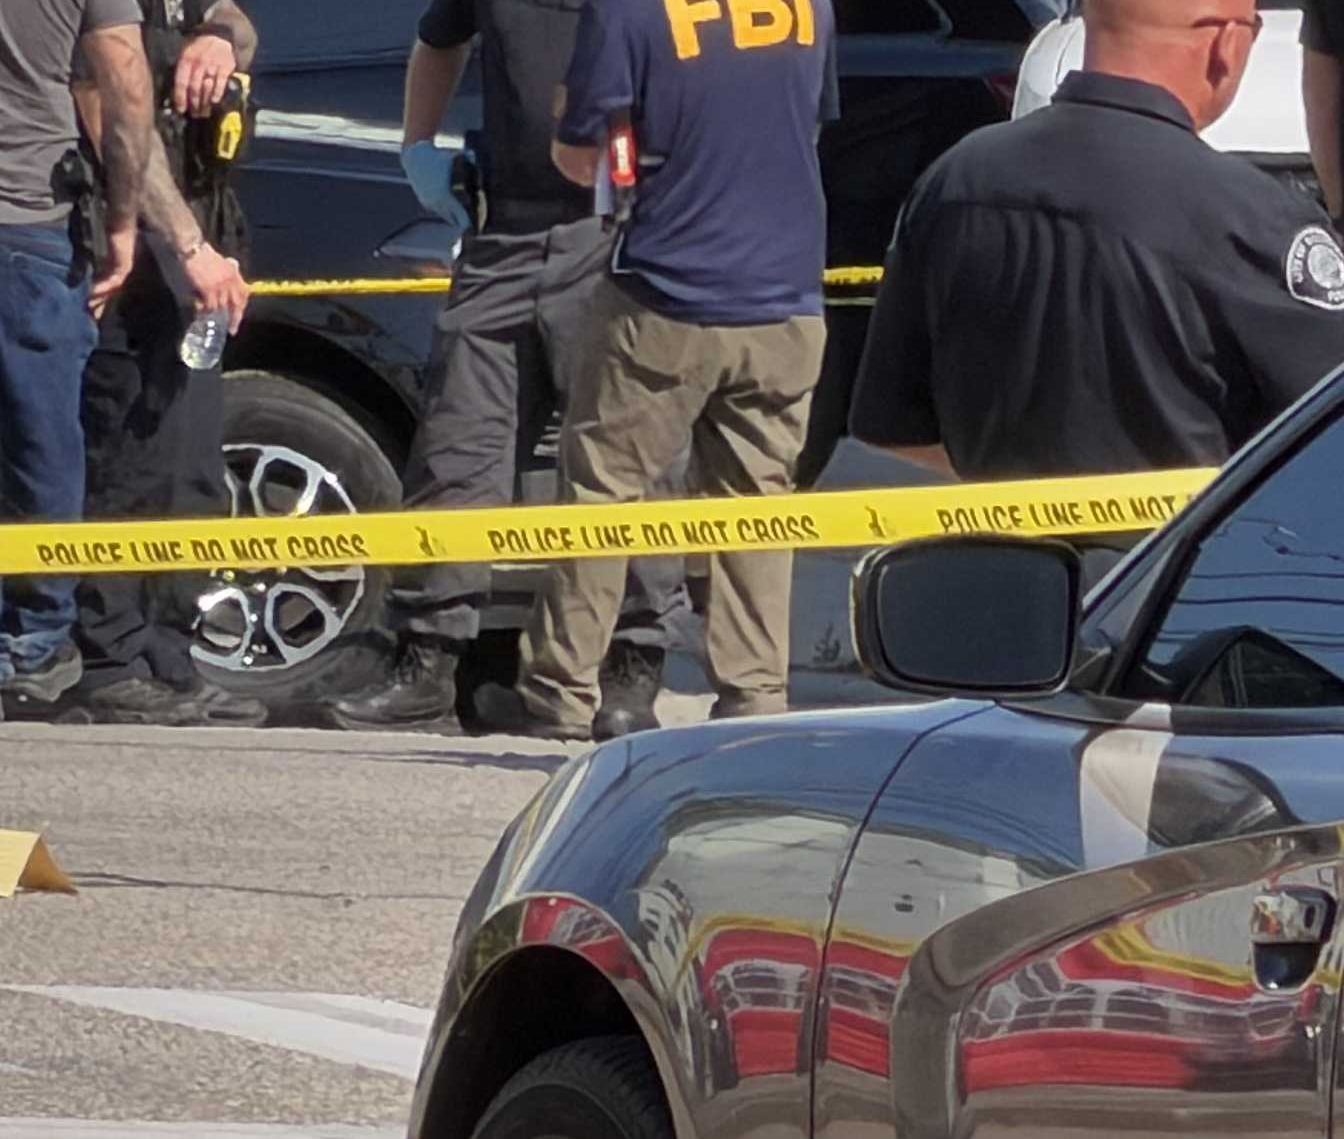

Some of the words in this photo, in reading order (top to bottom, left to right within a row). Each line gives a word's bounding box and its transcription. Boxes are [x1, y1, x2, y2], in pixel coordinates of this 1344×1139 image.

[936, 505, 1022, 533] POLICE
[1029, 501, 1084, 528] LINE
[1089, 497, 1126, 524] DO
[1129, 495, 1177, 521] NOT
[37, 543, 123, 566] POLICE
[130, 540, 185, 564] LINE
[191, 539, 225, 561] DO
[235, 538, 278, 560] NOT
[287, 533, 370, 559] CROSS
[487, 526, 575, 554] POLICE
[580, 523, 635, 550] LINE
[641, 521, 677, 547] DO
[684, 520, 730, 545] NOT
[736, 514, 821, 543] CROSS
